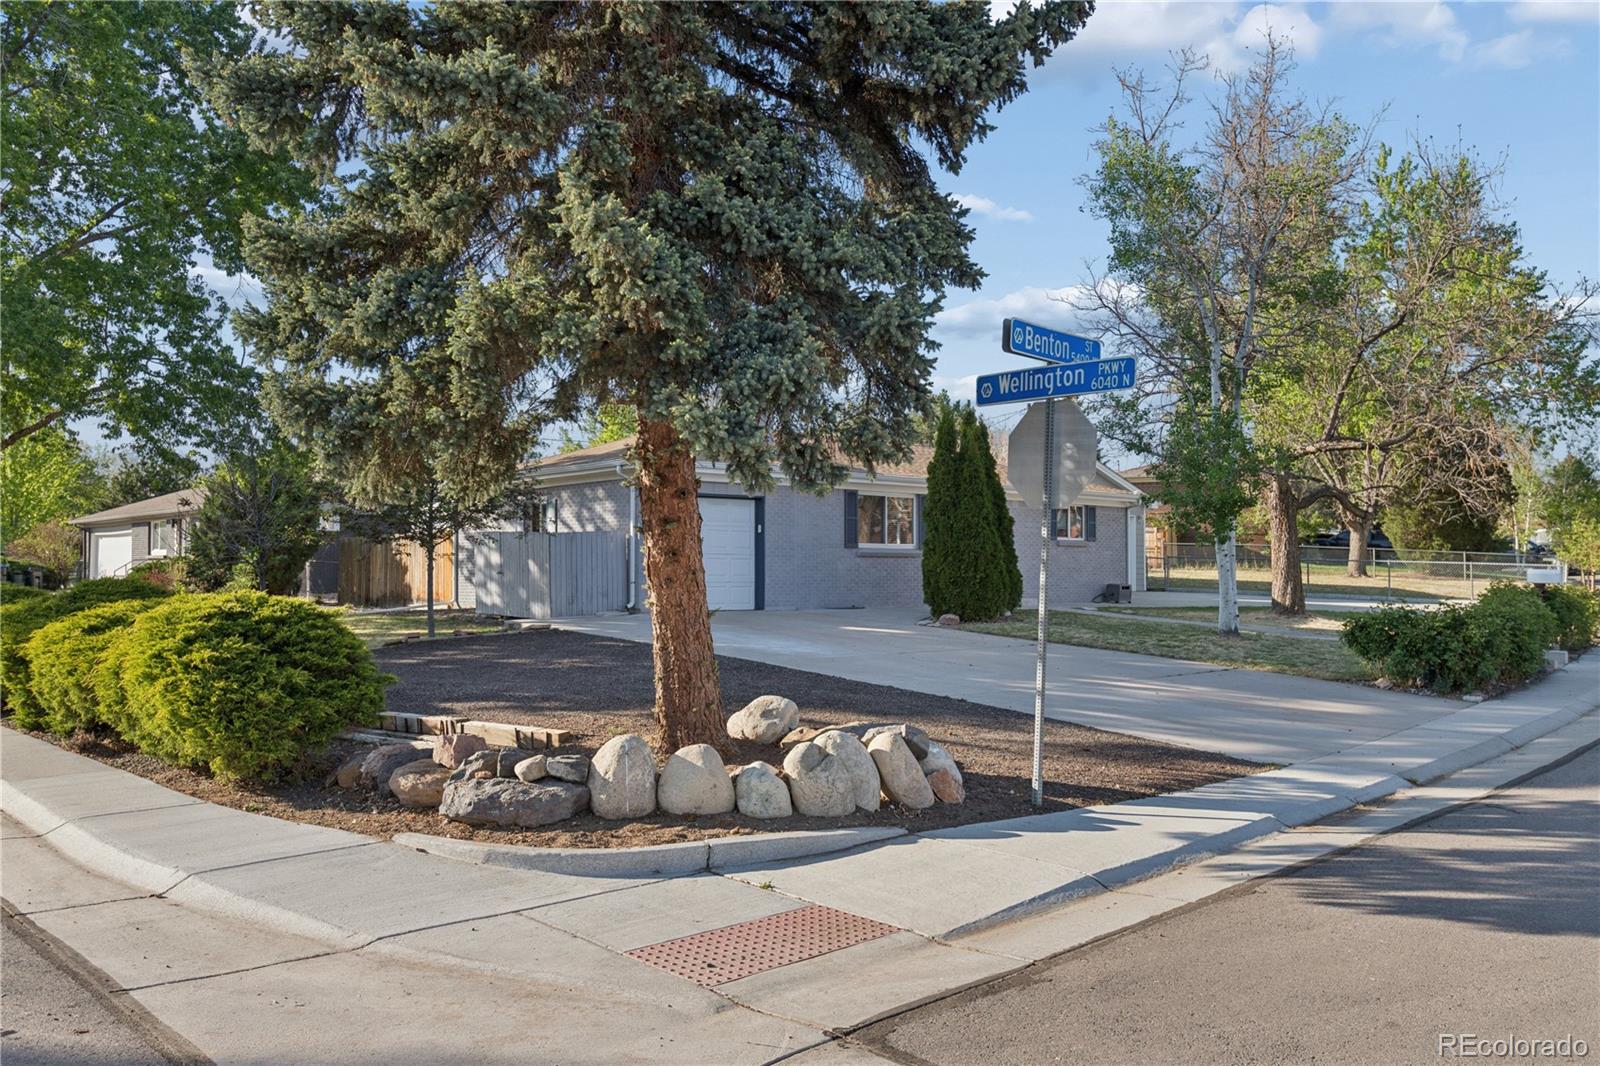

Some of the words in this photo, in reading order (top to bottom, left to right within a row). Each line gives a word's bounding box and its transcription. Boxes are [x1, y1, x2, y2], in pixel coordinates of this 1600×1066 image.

[1025, 326, 1069, 360] Benton
[1085, 341, 1093, 353] ST
[1098, 360, 1127, 375] PKWY
[999, 368, 1085, 395] Wellington
[1091, 375, 1118, 390] 6040
[1123, 374, 1130, 386] N
